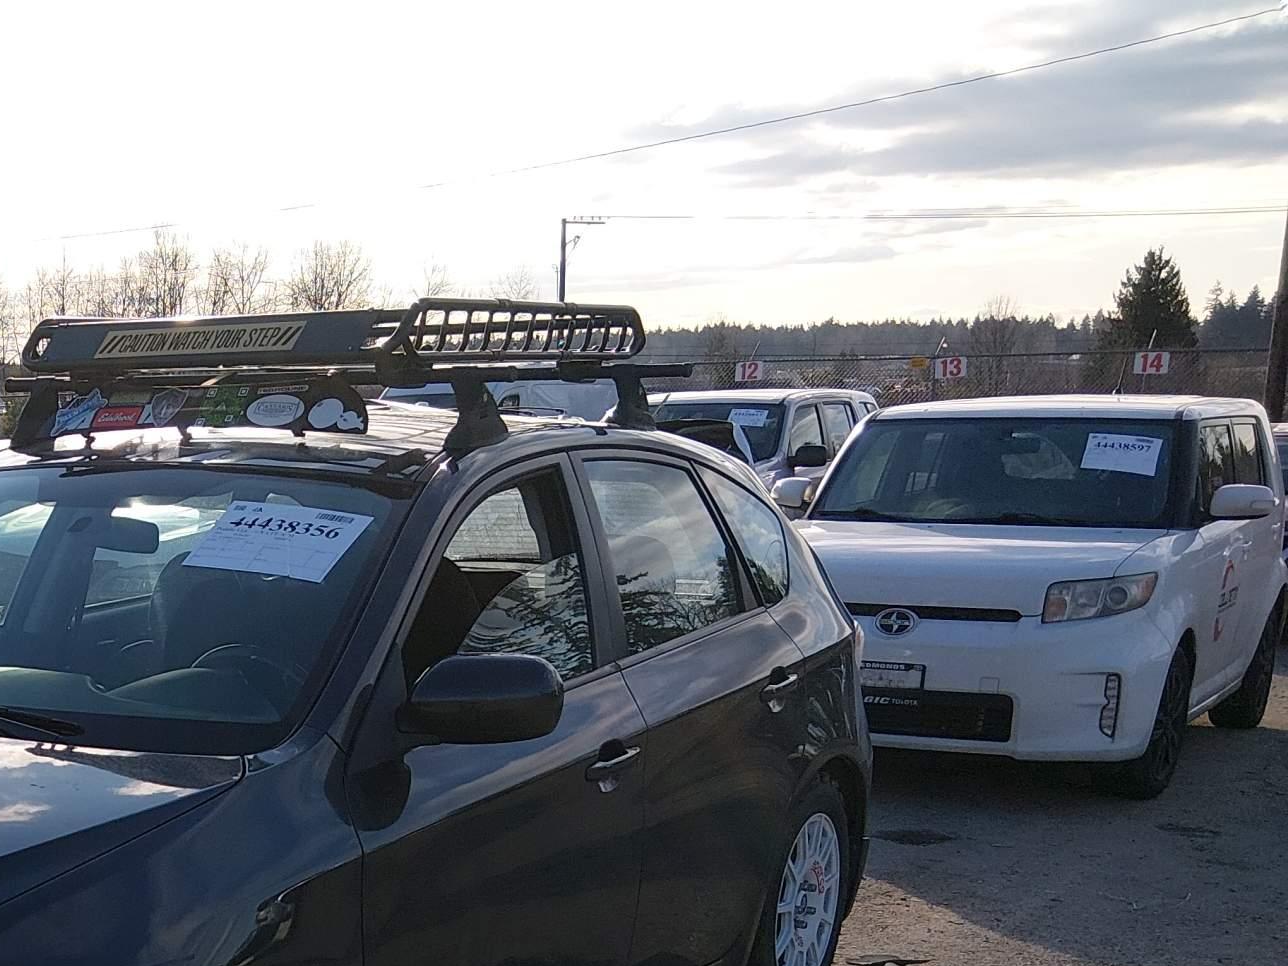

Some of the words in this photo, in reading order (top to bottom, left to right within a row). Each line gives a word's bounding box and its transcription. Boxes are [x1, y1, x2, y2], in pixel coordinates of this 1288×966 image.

[118, 331, 169, 353] CAUTION
[169, 329, 214, 350] WATCH
[211, 327, 247, 348] YOUR
[243, 326, 281, 347] STEP
[741, 362, 759, 380] 12
[940, 357, 962, 378] 13
[1140, 353, 1164, 373] 14
[230, 516, 344, 540] 44438356
